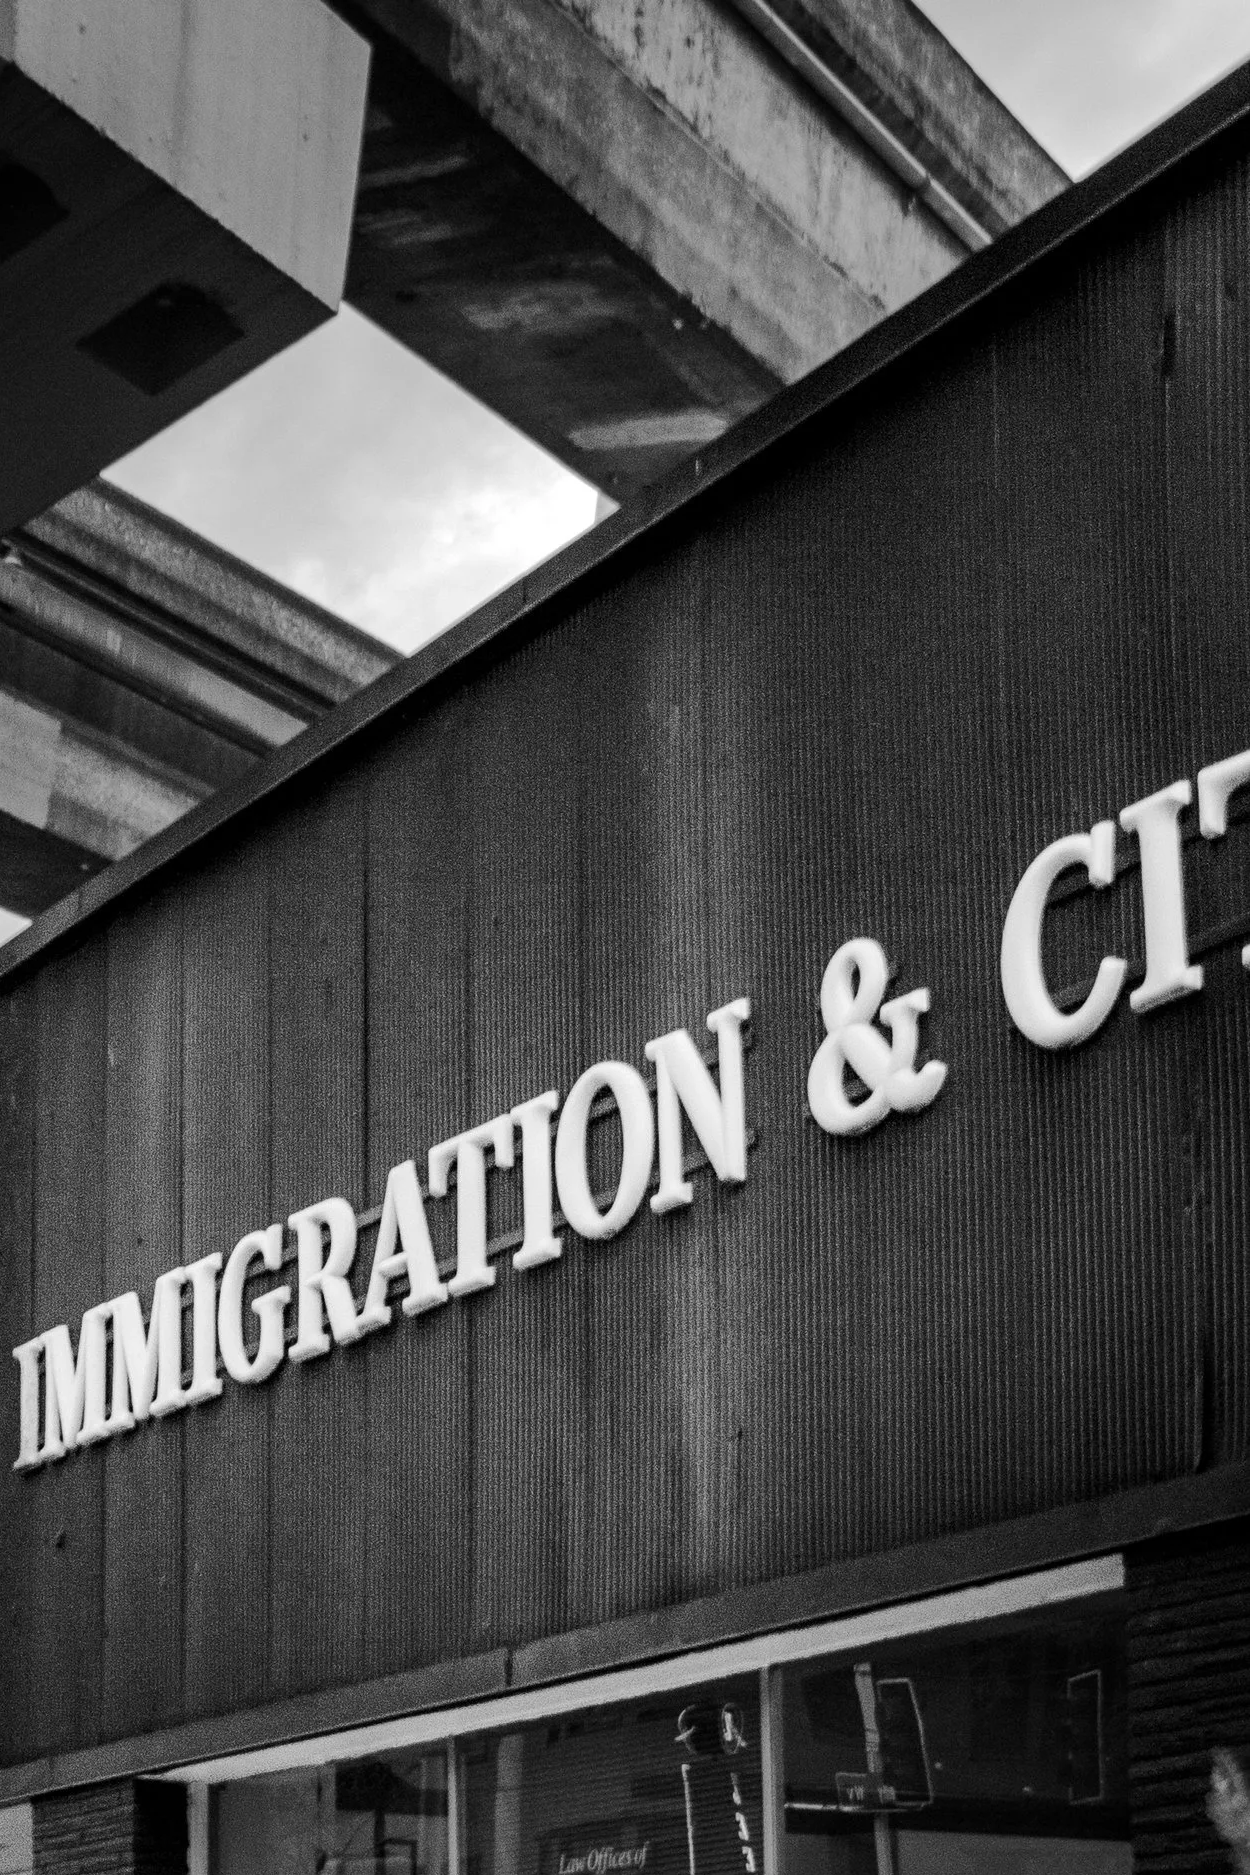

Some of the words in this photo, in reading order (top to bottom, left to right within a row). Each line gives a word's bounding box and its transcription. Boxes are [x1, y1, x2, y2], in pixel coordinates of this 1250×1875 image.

[12, 998, 752, 1473] IMMIGRATION
[806, 938, 947, 1138] &
[558, 1851, 586, 1875] Law
[587, 1844, 631, 1874] Offices
